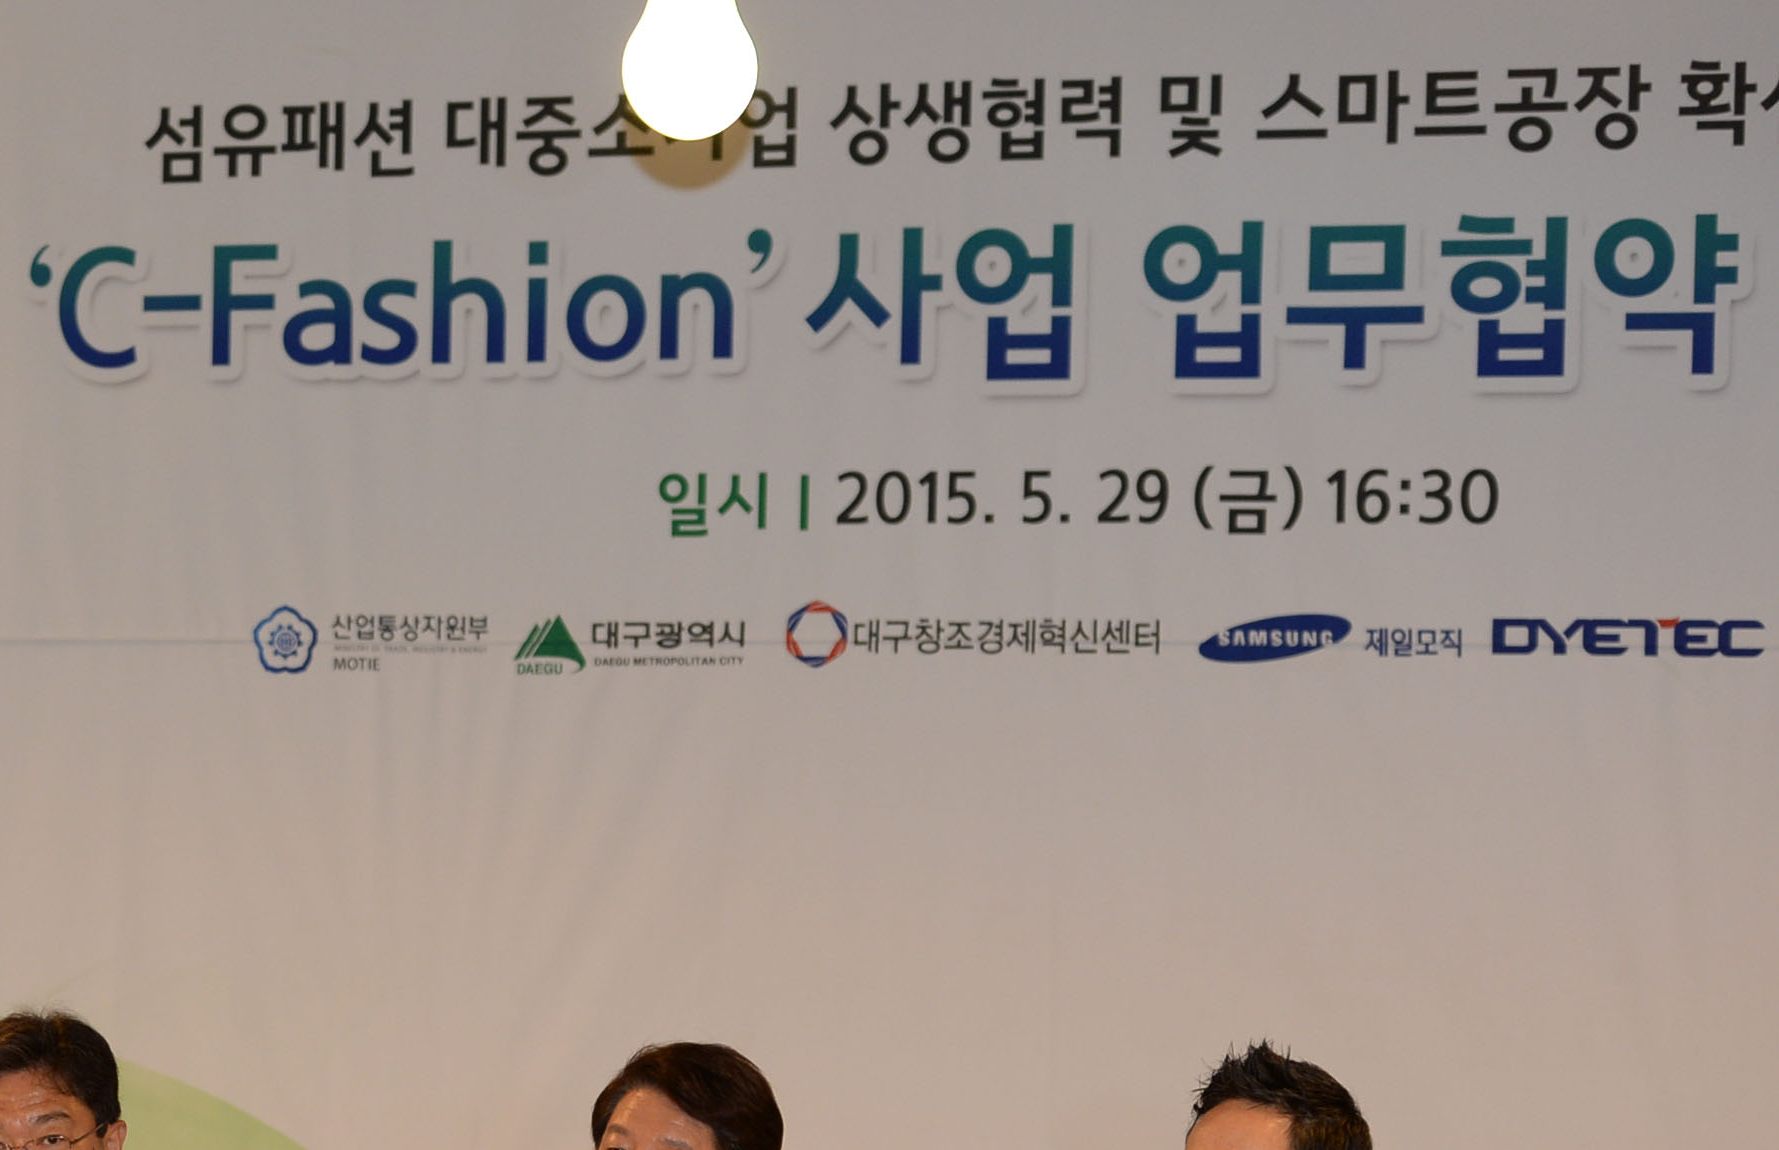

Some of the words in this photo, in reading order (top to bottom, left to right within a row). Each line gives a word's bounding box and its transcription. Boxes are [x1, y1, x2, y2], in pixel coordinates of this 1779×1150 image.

[144, 99, 415, 184] 섬유패션
[446, 86, 799, 177] 대중소업
[829, 75, 1123, 165] 상생협력
[1159, 73, 1223, 158] 및
[1256, 63, 1653, 153] 스마트공장
[805, 223, 1074, 381] 사업
[1143, 213, 1740, 379] 업무협약
[658, 471, 768, 537] 일시
[836, 470, 995, 525] 2015.
[1022, 470, 1070, 525] 5.
[1097, 468, 1169, 524] 29
[1193, 465, 1303, 535] (금)
[1326, 468, 1499, 525] 16:30
[332, 614, 488, 642] 산업통상자원부
[591, 620, 746, 650] 대구광역시
[852, 618, 1161, 655] 대구창조경제혁신센터
[1218, 629, 1334, 648] SAMSUNG
[1364, 627, 1463, 658] 제일모직
[1491, 617, 1765, 658] DYETEC
[333, 656, 380, 672] MOTIE
[516, 663, 563, 675] DAEGU
[593, 657, 631, 667] DAEGU
[632, 656, 716, 666] METROPOLITAN
[719, 655, 744, 666] CITY
